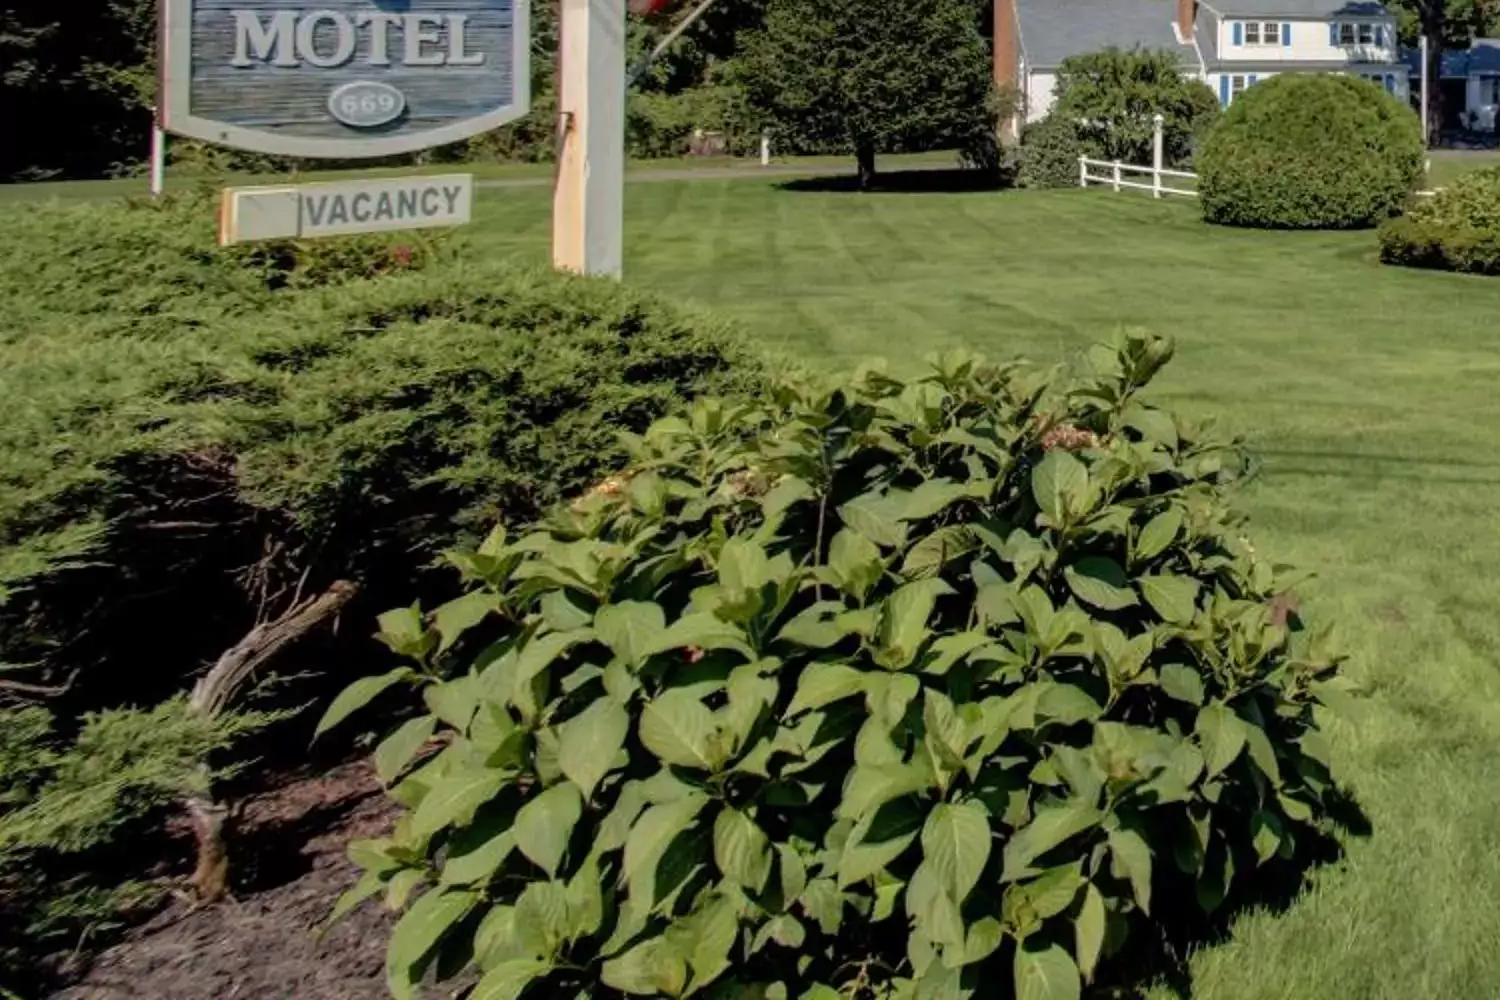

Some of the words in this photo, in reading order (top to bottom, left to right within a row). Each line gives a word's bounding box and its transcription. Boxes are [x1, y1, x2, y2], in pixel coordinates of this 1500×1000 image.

[231, 9, 485, 66] MOTEL
[341, 93, 395, 115] 669
[304, 185, 462, 227] VACANCY
